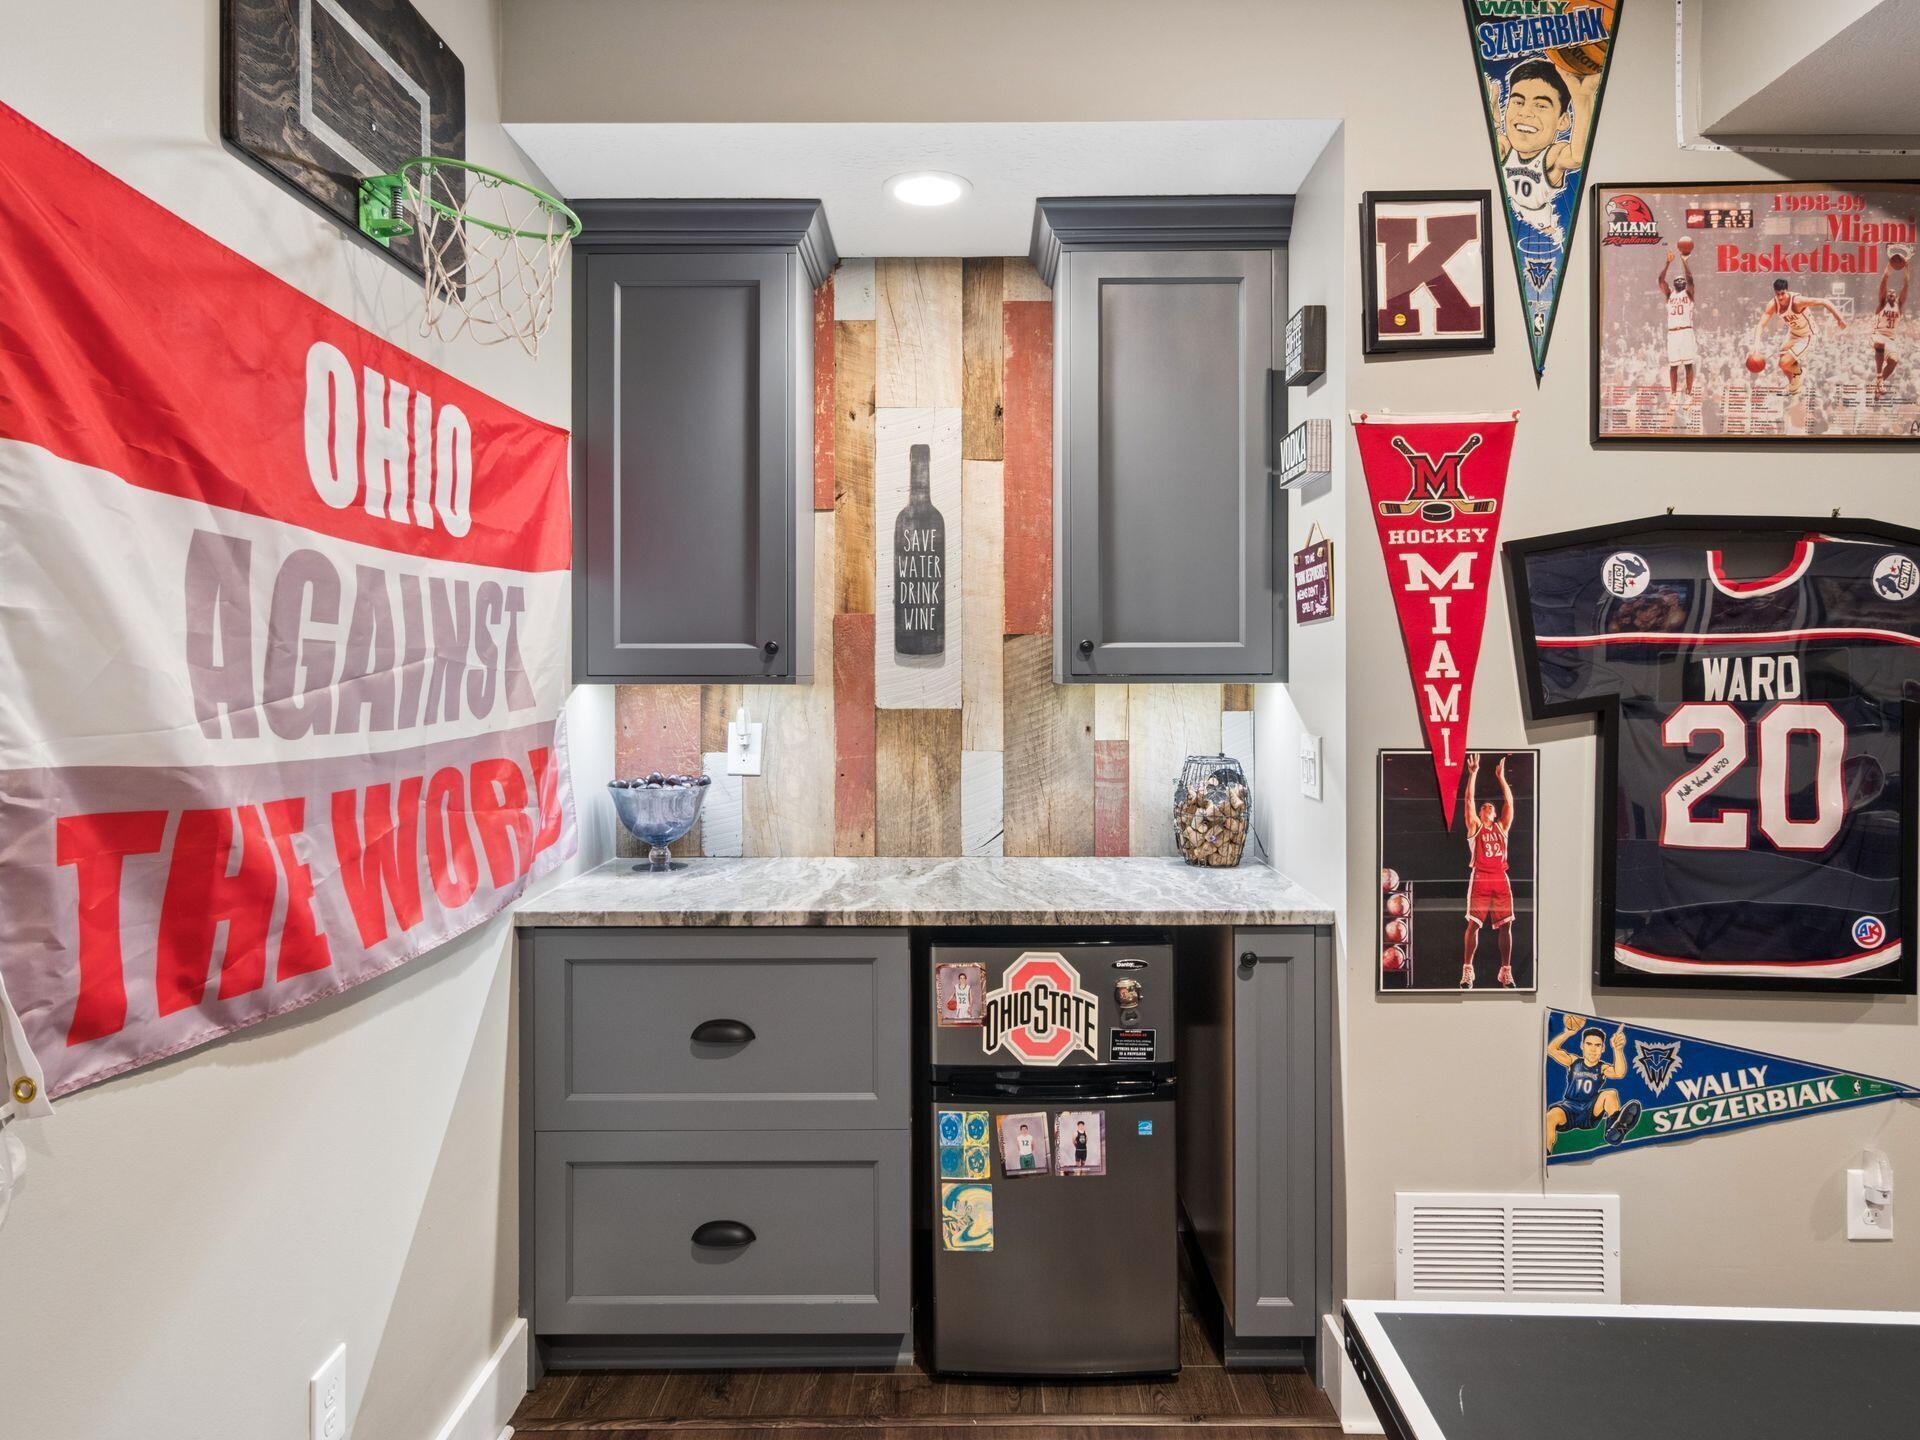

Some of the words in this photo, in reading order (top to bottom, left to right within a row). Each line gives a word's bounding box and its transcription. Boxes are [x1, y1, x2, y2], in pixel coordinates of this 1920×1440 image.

[1479, 0, 1568, 15] WALLY
[1479, 7, 1609, 59] SZCZERBIAK
[1512, 179, 1531, 197] 10
[1773, 194, 1866, 213] 1998-99
[1608, 221, 1658, 233] MIAMI
[1826, 214, 1917, 243] Miami
[1716, 243, 1878, 274] Basketball
[1376, 213, 1483, 336] K
[304, 341, 471, 538] OHIO
[1280, 425, 1306, 474] VODKA
[903, 529, 937, 552] SAVE
[1388, 528, 1489, 545] HOCKEY
[899, 555, 942, 578] WATER
[900, 581, 939, 604] DRINK
[184, 528, 537, 740] AGAINST
[904, 608, 936, 631] WINE
[1702, 655, 1801, 702] WARD
[1659, 701, 1848, 851] 20
[1485, 842, 1503, 858] 32
[57, 797, 331, 1047] THE
[986, 991, 1031, 1052] OHIO
[1034, 984, 1096, 1054] STATE
[1576, 1079, 1592, 1094] 10
[1675, 1065, 1768, 1101] WALLY
[1653, 1079, 1840, 1133] SZCZERBIAK
